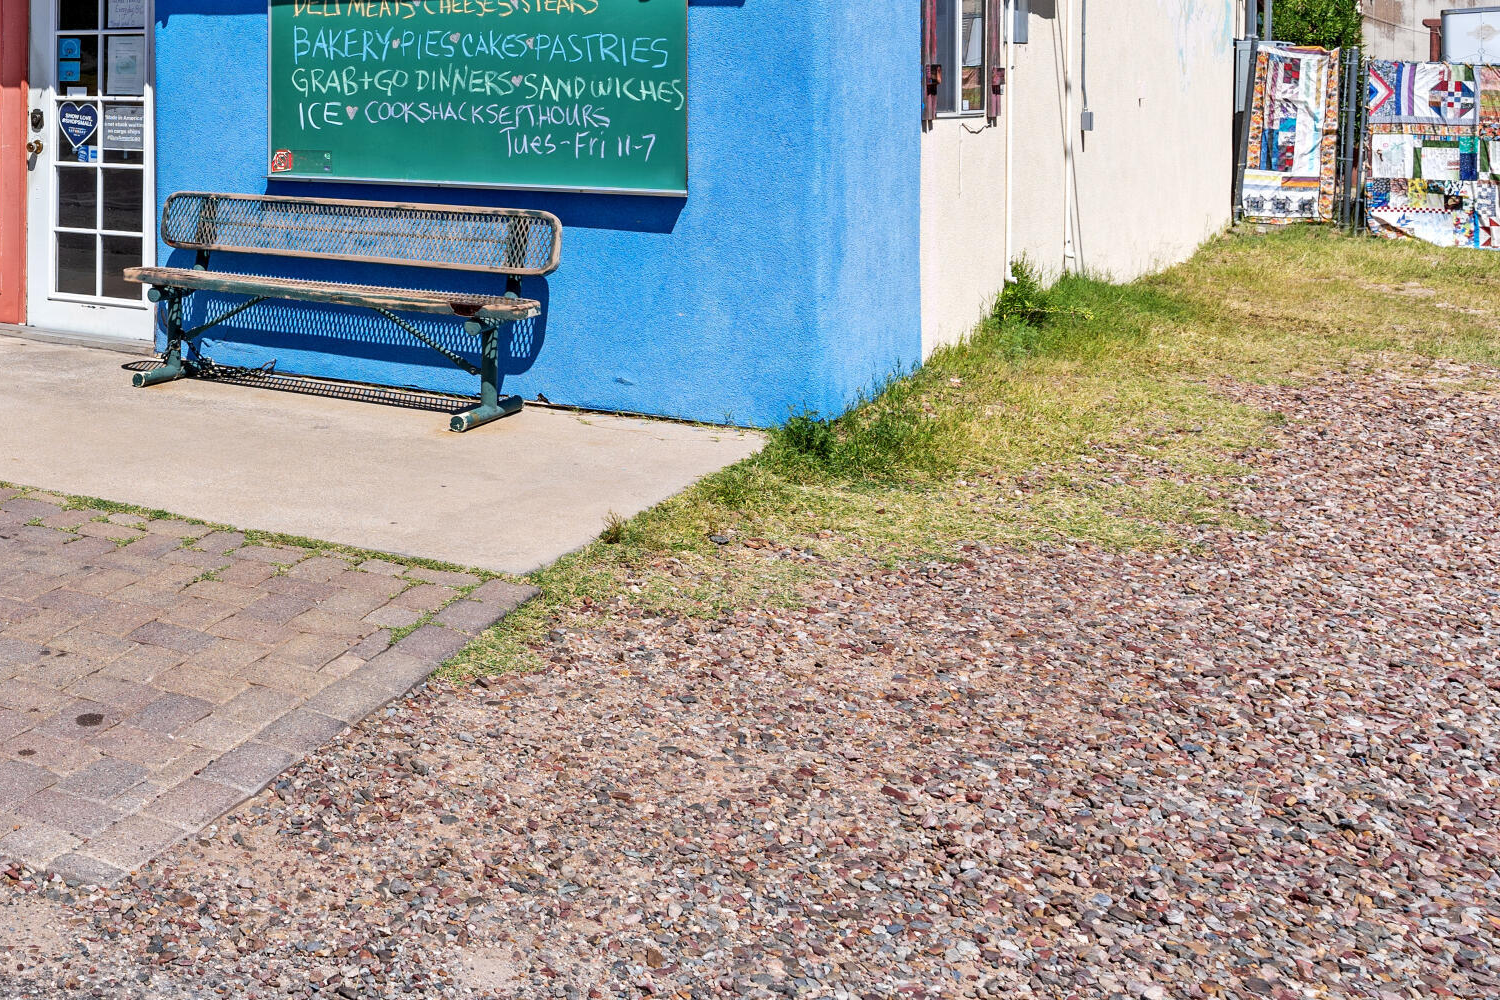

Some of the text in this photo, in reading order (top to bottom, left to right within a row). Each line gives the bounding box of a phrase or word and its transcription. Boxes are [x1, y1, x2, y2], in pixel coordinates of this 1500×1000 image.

[293, 25, 668, 69] BAKERY PIES CAKES PASTRIES
[415, 63, 514, 96] DINNERS
[524, 73, 685, 111] SANDWICHES
[299, 102, 344, 130] ICE
[618, 134, 656, 162] 11-7
